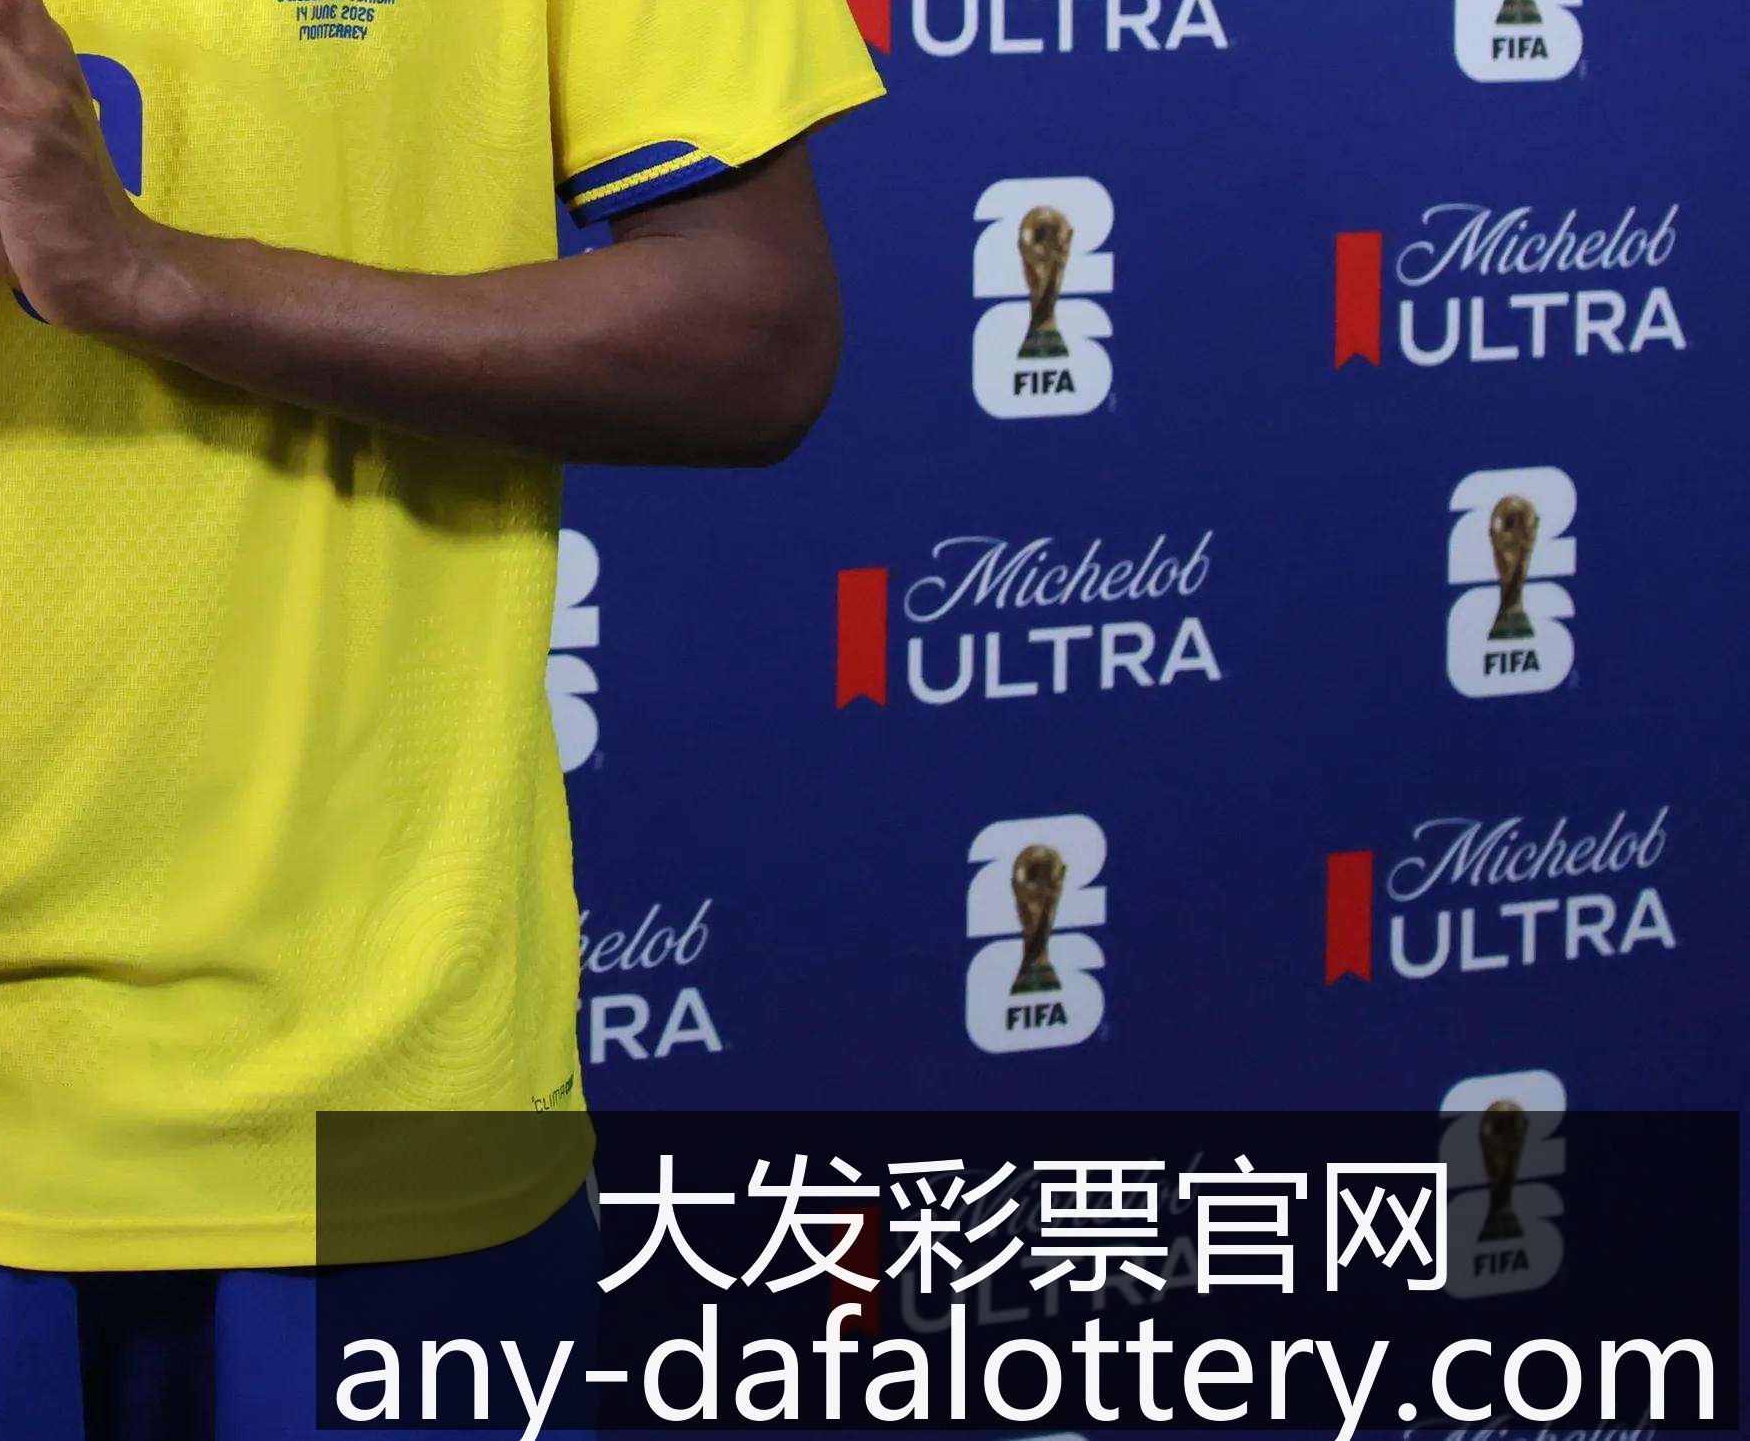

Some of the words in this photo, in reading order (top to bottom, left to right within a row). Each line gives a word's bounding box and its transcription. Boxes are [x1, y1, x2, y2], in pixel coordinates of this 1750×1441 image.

[296, 5, 308, 22] 14
[311, 4, 339, 21] JUNE
[341, 5, 375, 23] 2026
[299, 22, 368, 41] MONTERREY
[1491, 36, 1549, 60] FIFA
[1396, 203, 1679, 287] Michelob
[1399, 286, 1687, 367] ULTRA
[1013, 369, 1076, 397] FIFA
[904, 530, 1213, 623] Michelob
[907, 616, 1222, 705] ULTRA
[1483, 649, 1541, 676] FIFA
[1387, 805, 1670, 902] Michelob
[1390, 888, 1676, 979] ULTRA
[1005, 1001, 1068, 1032] FIFA
[1473, 1249, 1530, 1279] FIFA
